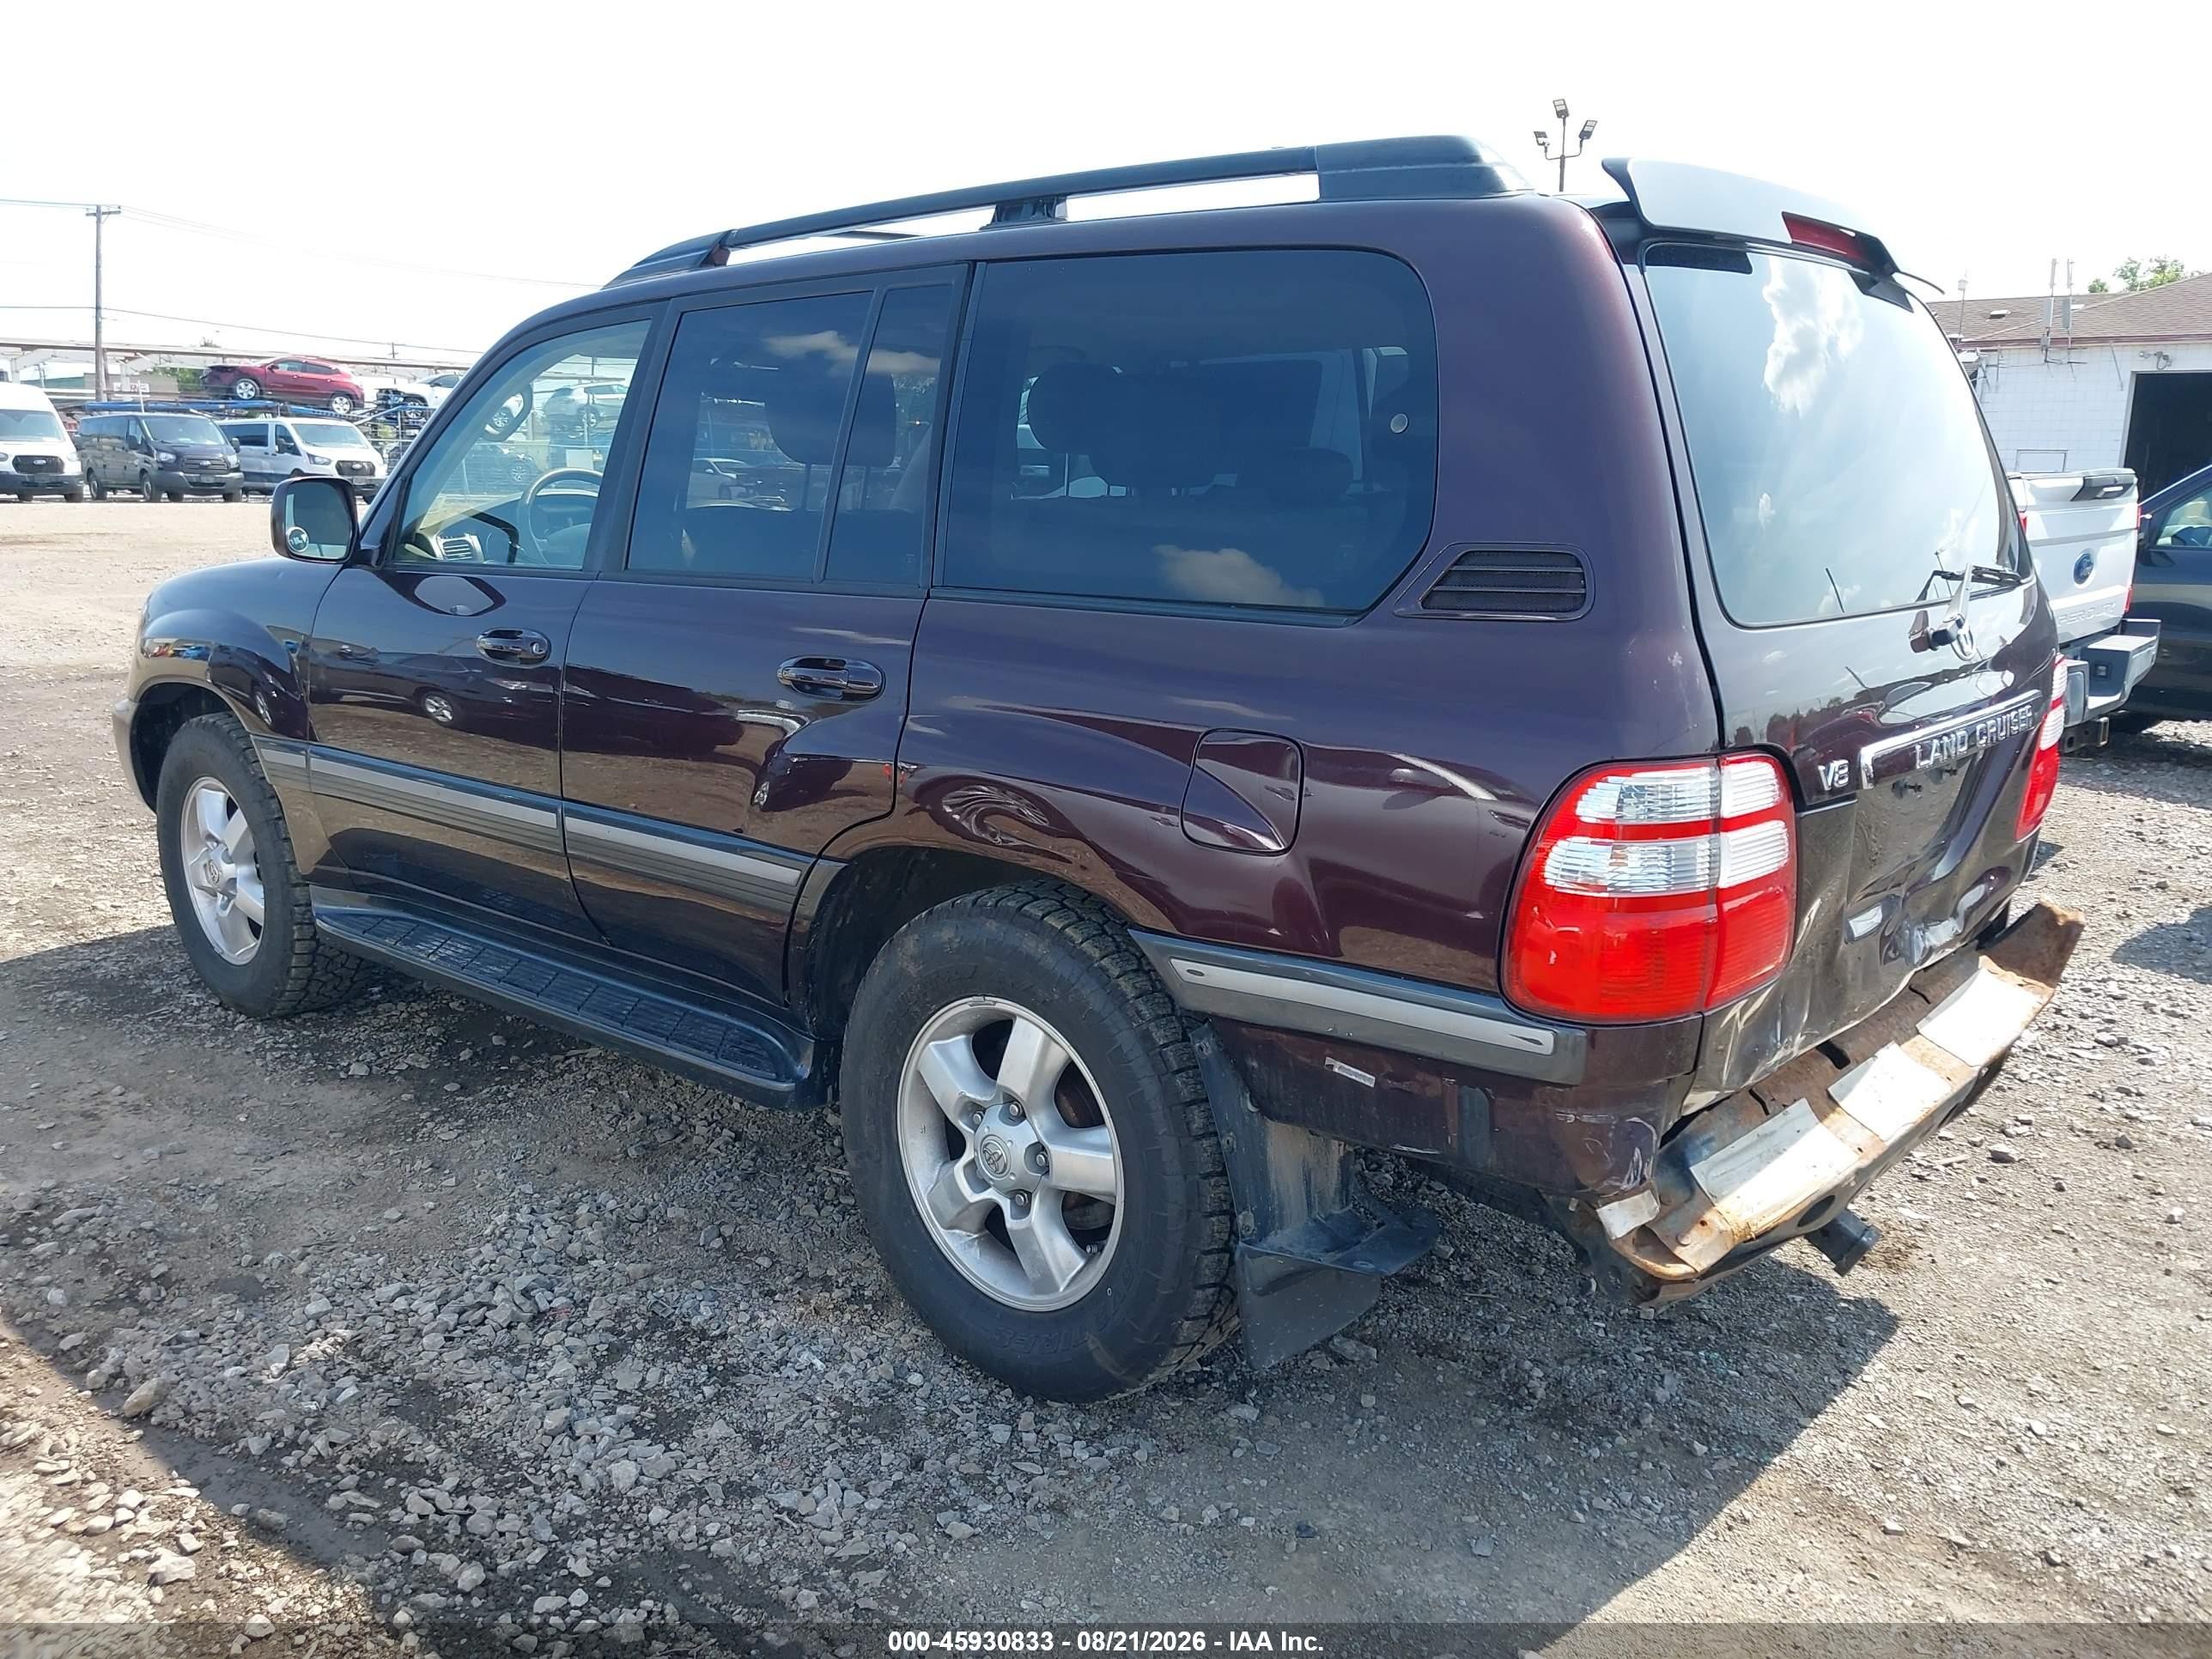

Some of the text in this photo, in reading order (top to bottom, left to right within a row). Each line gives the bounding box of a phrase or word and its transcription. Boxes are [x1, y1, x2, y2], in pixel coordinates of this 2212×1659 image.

[1915, 704, 2033, 769] LAND CRUISER
[1818, 759, 1849, 791] V8
